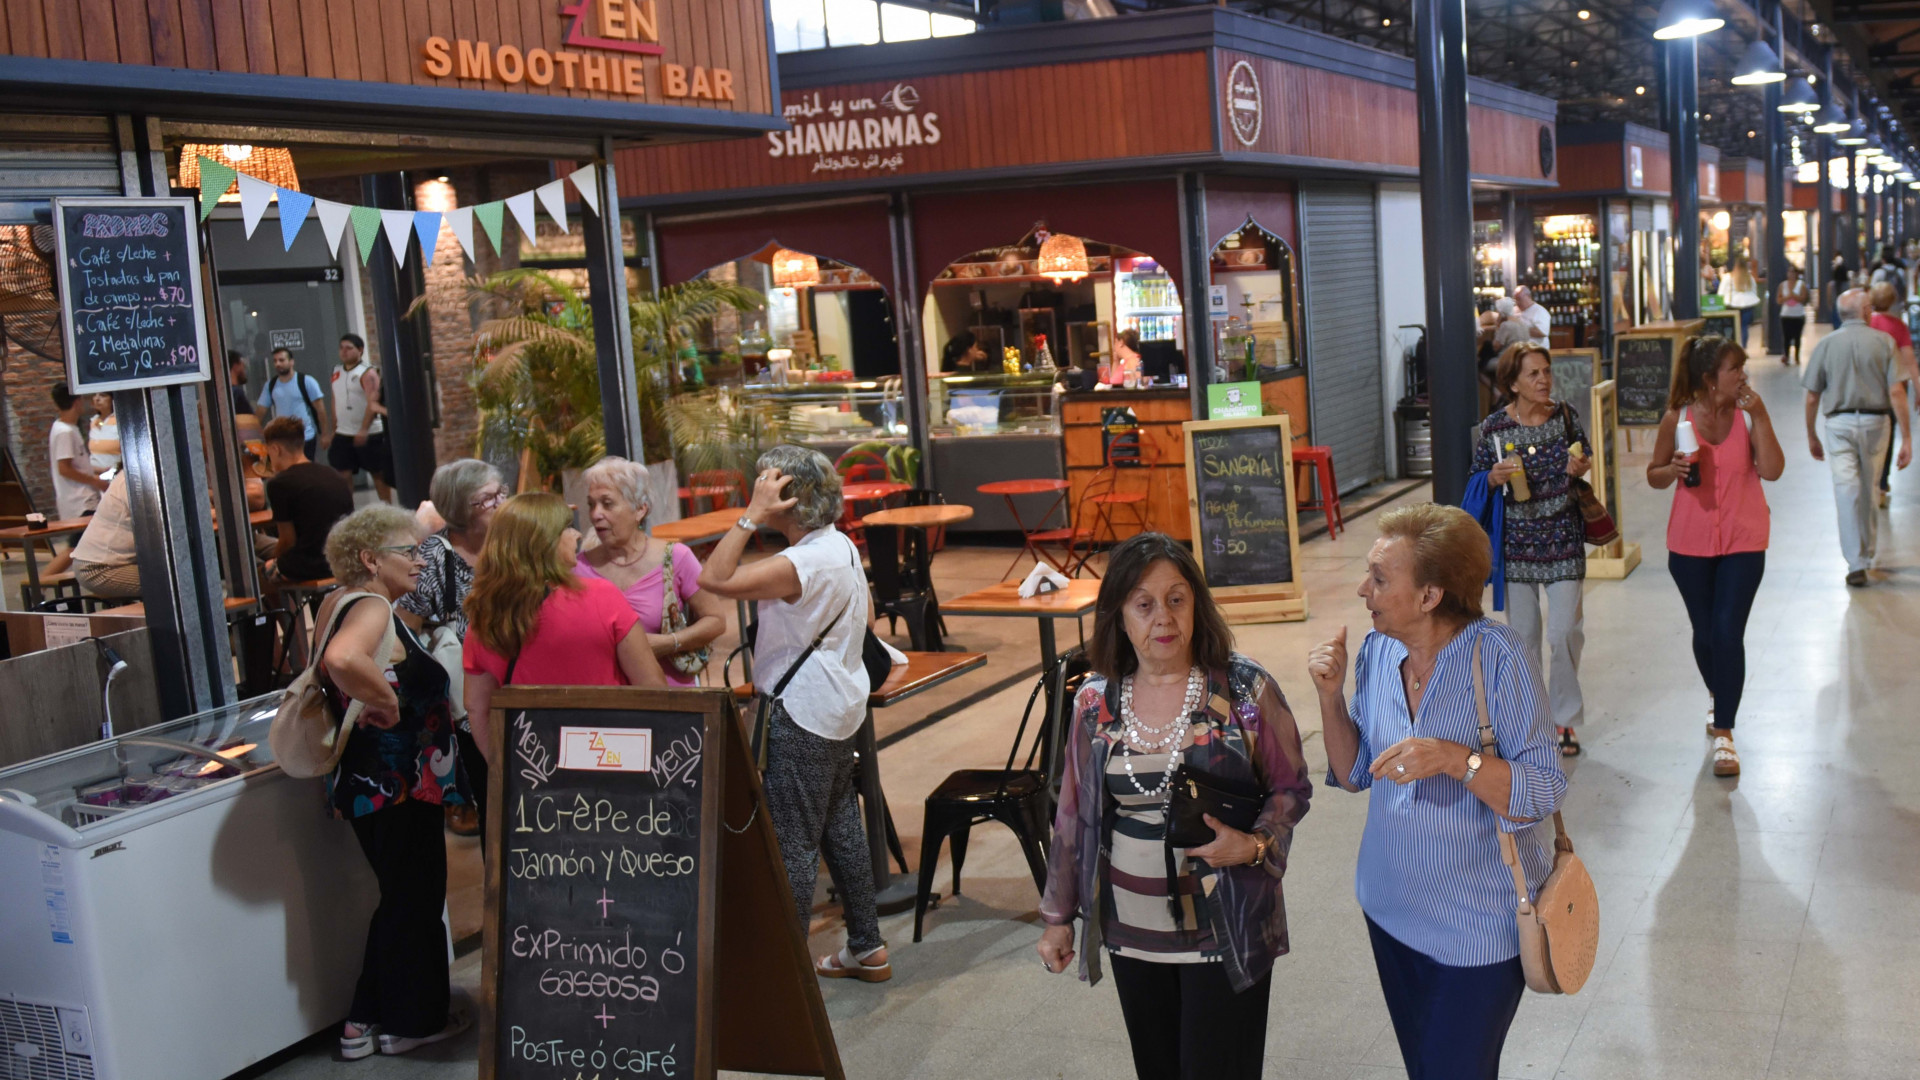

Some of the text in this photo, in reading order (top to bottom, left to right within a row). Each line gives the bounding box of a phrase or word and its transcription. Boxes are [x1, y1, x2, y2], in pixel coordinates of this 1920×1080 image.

[423, 36, 735, 101] SMOOTHIE BAR
[783, 92, 876, 122] mil y un
[768, 112, 941, 158] SHAWARMAS
[83, 213, 169, 238] PROMOS
[79, 247, 111, 267] Café
[83, 267, 180, 288] Tostadas de pan
[324, 269, 338, 280] 32
[84, 291, 99, 305] de
[159, 286, 185, 303] $70
[86, 313, 121, 333] Café
[88, 330, 165, 356] 2 Medialunas
[273, 333, 300, 342] BAZAR
[98, 359, 117, 372] con
[120, 352, 131, 370] J
[134, 357, 140, 376] y
[141, 350, 152, 369] Q
[170, 345, 197, 366] $90
[1206, 500, 1239, 516] AGUA
[515, 794, 533, 832] 1
[636, 798, 672, 835] de
[510, 848, 594, 880] Jamón
[619, 845, 695, 878] Queso
[539, 968, 660, 1002] Gaseosa
